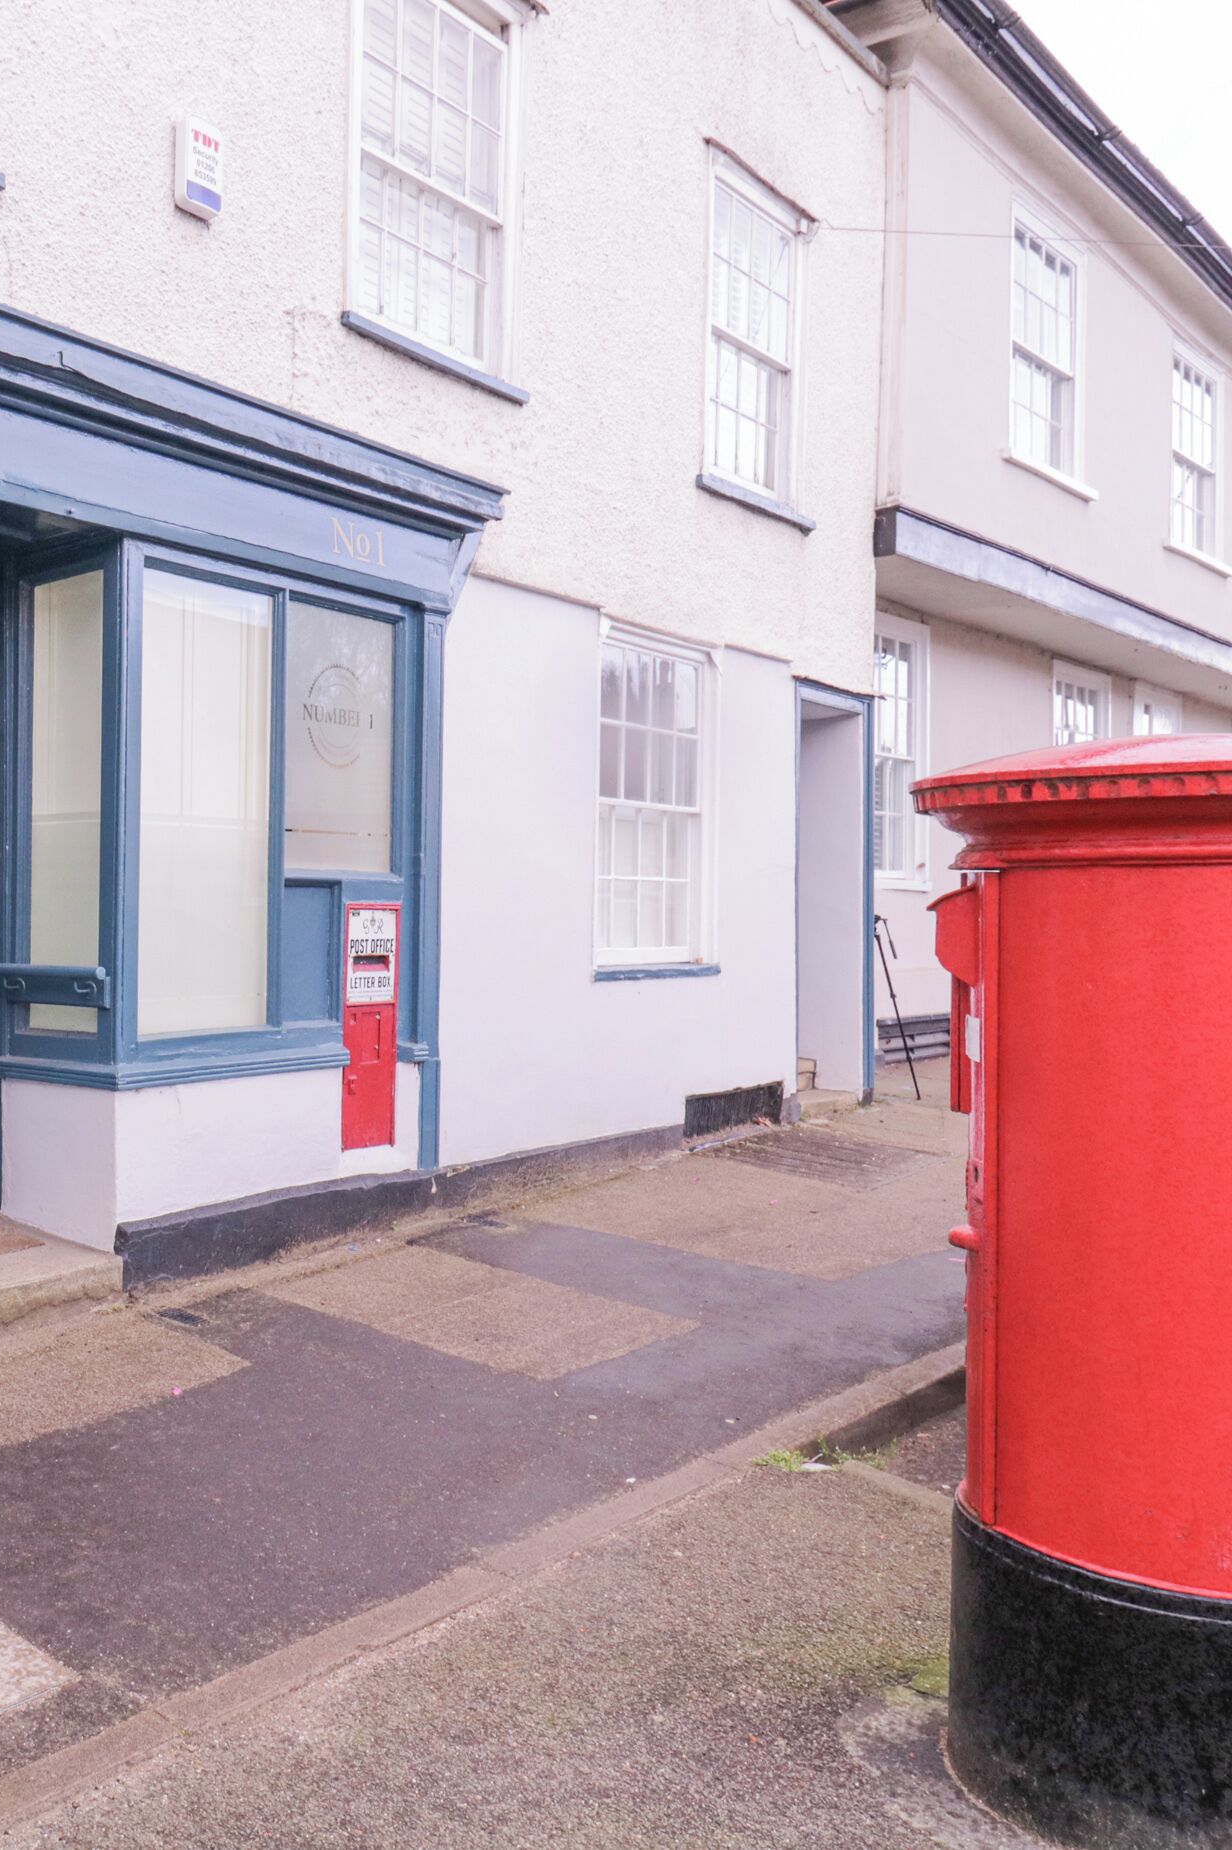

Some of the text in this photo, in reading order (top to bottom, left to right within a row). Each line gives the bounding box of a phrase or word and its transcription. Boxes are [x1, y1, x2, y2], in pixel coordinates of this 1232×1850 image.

[192, 128, 221, 153] TDT
[193, 146, 219, 166] Security
[350, 938, 394, 954] POST OFFICE
[350, 976, 375, 989] LETTER
